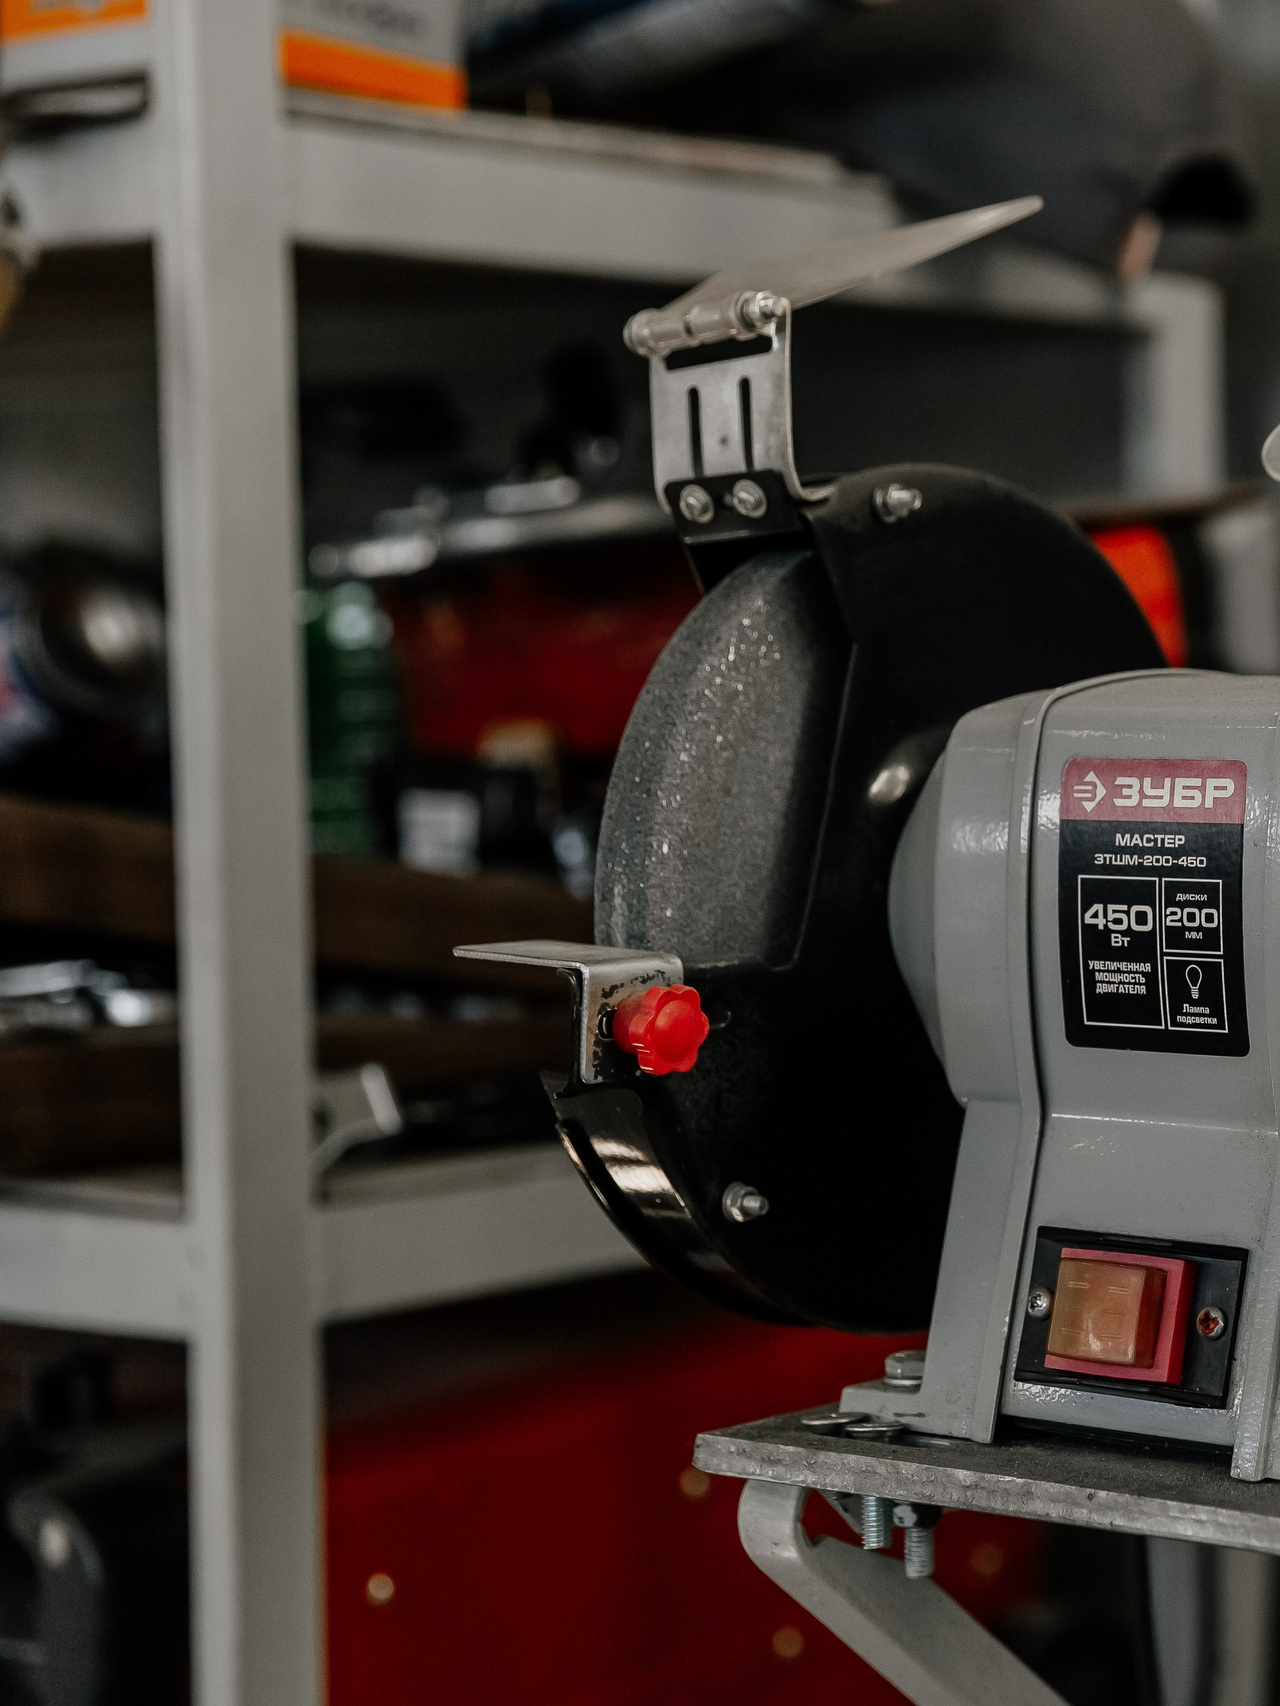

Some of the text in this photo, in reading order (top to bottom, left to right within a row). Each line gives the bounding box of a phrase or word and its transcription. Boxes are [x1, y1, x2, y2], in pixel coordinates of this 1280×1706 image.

[1113, 776, 1235, 809] ЗУБР
[1115, 833, 1186, 848] МАСТЕР
[1084, 903, 1154, 932] 450
[1165, 907, 1219, 928] 200
[1110, 933, 1131, 947] Вт
[1088, 960, 1151, 973] УВЕЛИЧЕННАЯ
[1095, 972, 1146, 984] МОЩНОСТЬ
[1096, 983, 1147, 995] ДВИГАТЕЛЯ
[1182, 1003, 1210, 1014] Лампа
[1176, 1015, 1218, 1025] подсветки
